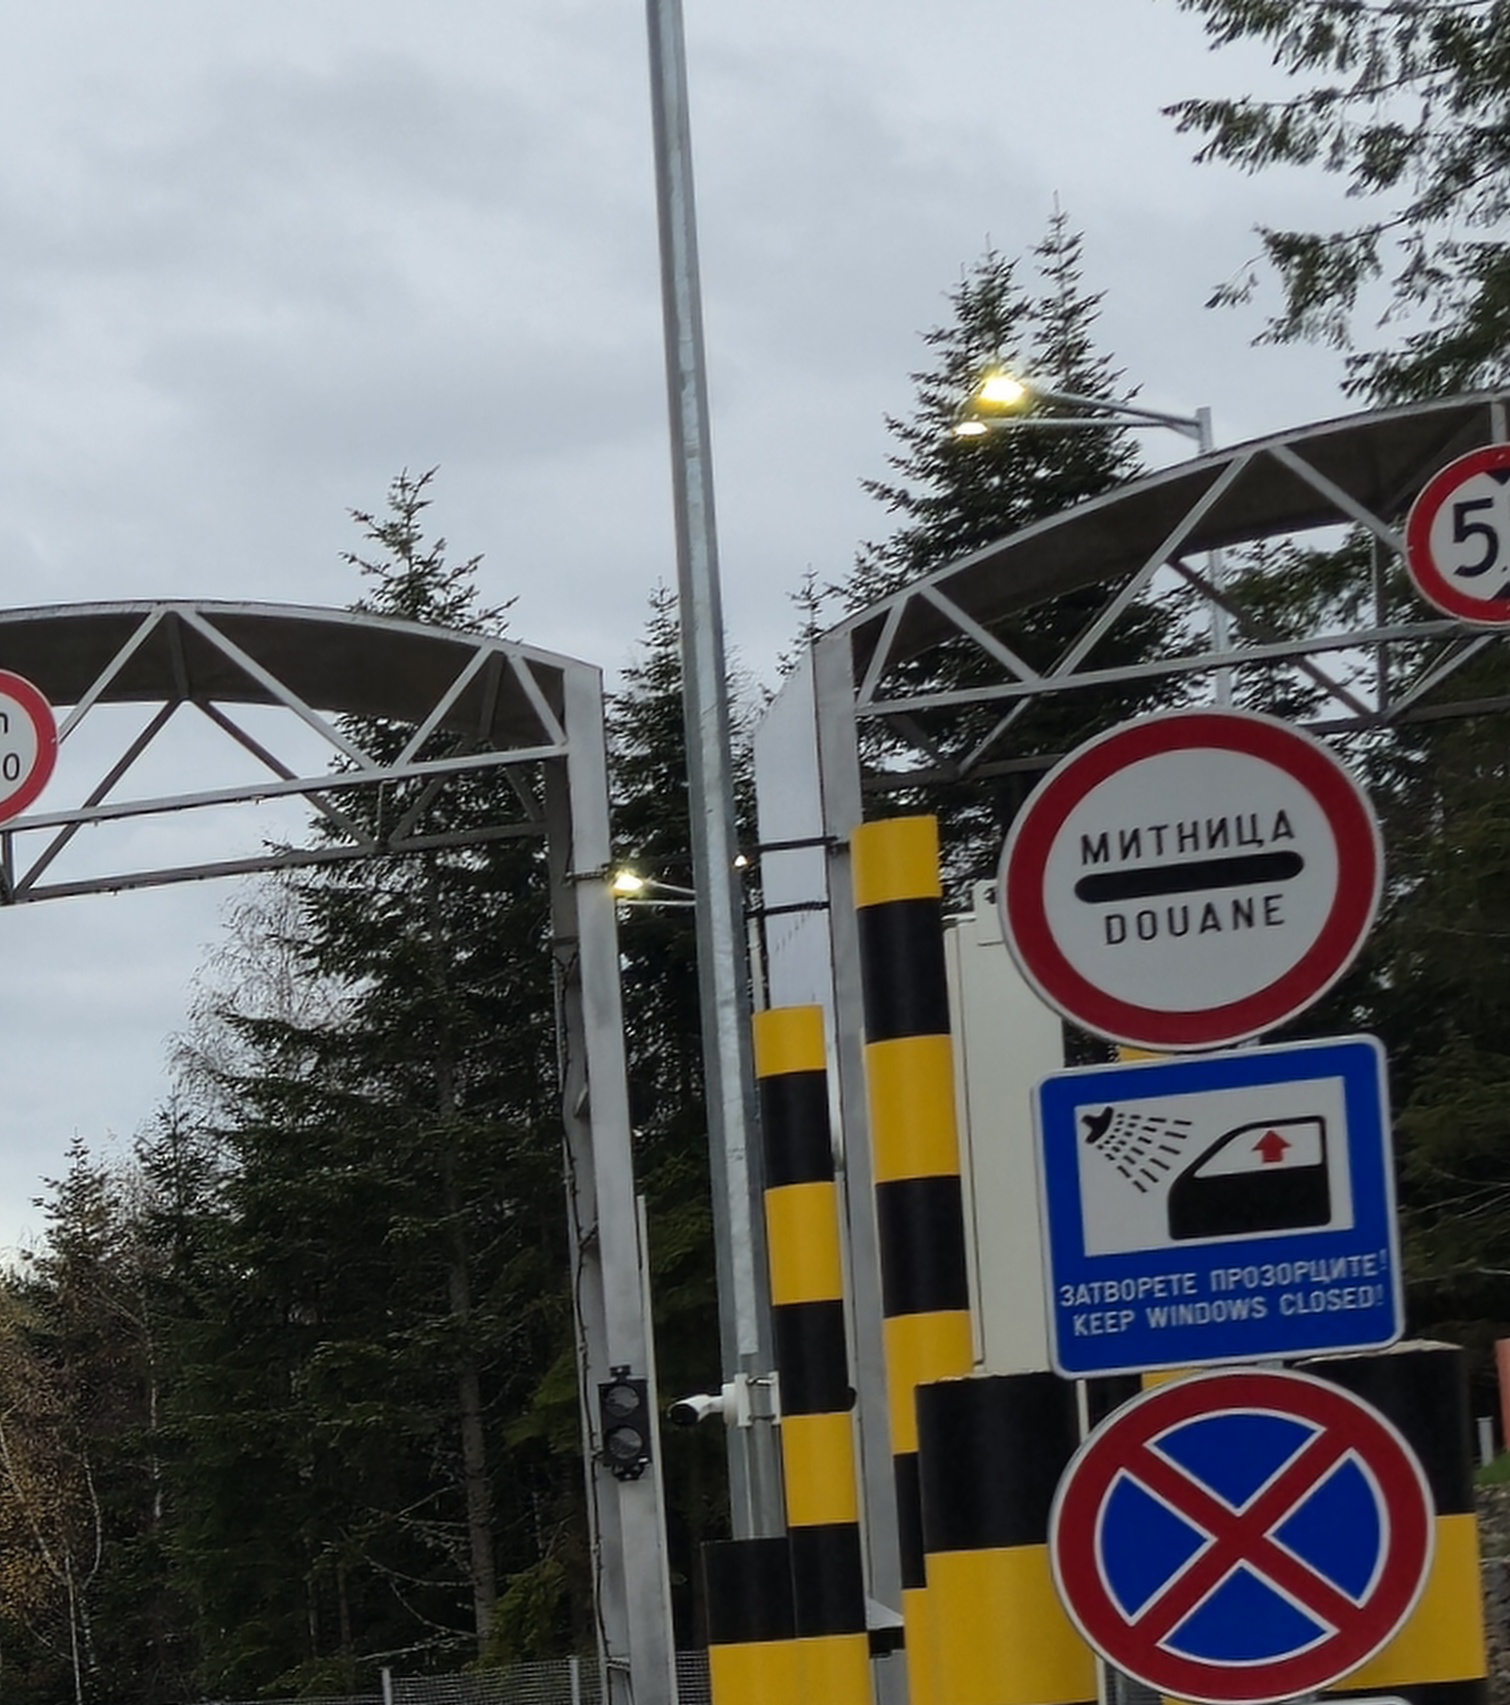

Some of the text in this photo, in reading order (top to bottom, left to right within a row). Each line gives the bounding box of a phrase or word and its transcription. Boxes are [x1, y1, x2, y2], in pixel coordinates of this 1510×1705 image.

[1080, 809, 1295, 865] МИТНИЦА
[1104, 894, 1285, 945] DOUANE
[1059, 1248, 1388, 1308] ЗАТВОРЕТЕ ПРОЗОРЦИТЕ!
[1073, 1283, 1385, 1337] KEEP WINDOWS CLOSED!
